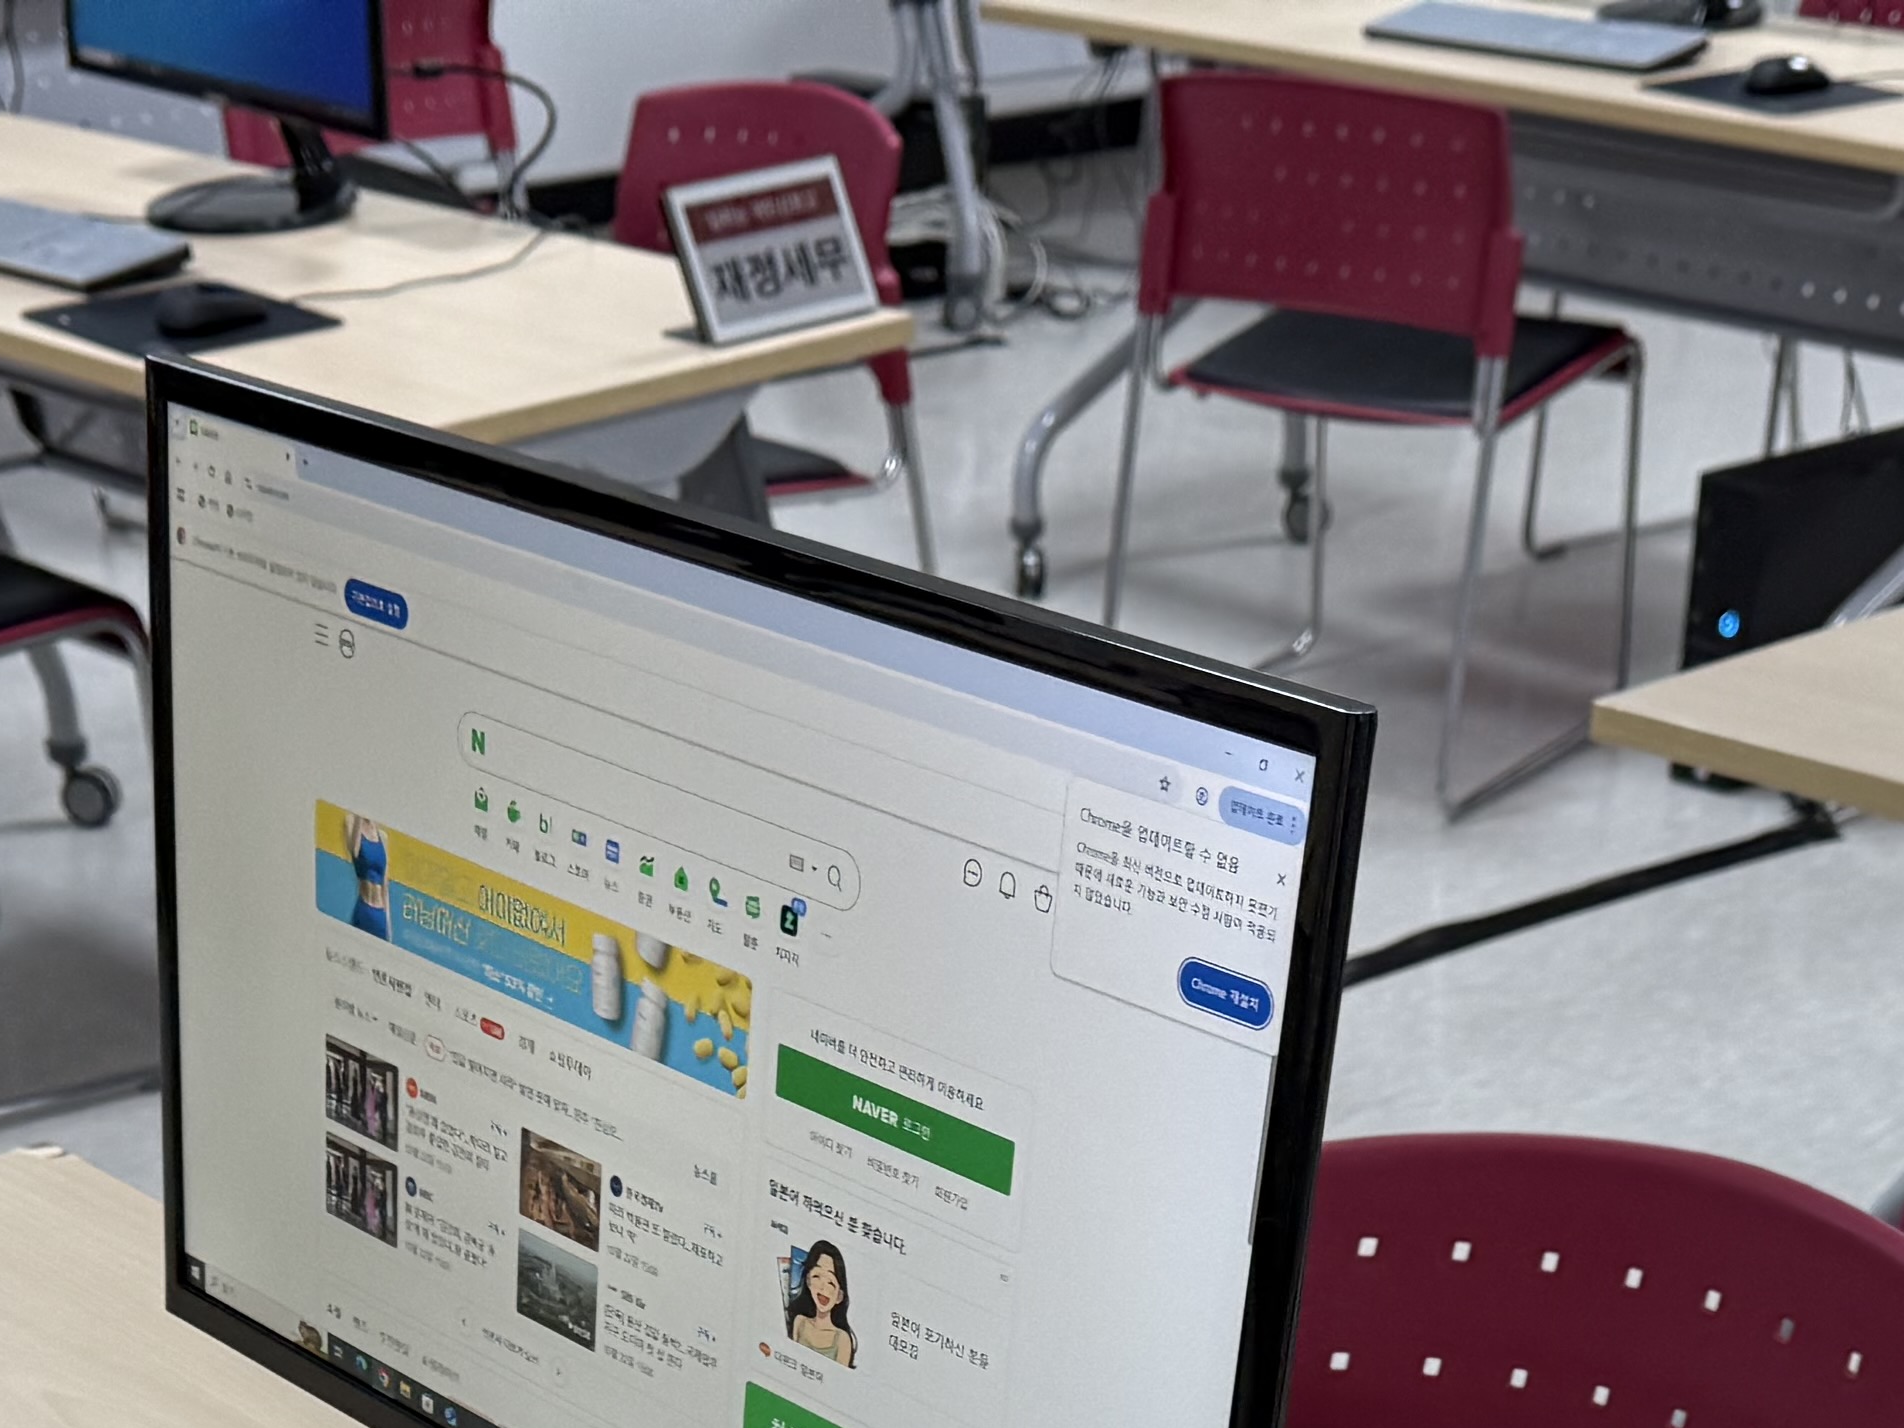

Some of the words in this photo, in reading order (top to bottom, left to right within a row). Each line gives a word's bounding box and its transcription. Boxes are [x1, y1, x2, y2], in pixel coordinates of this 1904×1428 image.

[711, 238, 851, 301] 재정세무
[471, 727, 485, 755] N
[1136, 824, 1195, 861] 업데이트할
[1198, 845, 1212, 863] 수
[1215, 850, 1239, 875] 없음
[1190, 975, 1227, 1001] Chrome
[852, 1093, 898, 1128] NAVER
[902, 1116, 931, 1143] 로그인
